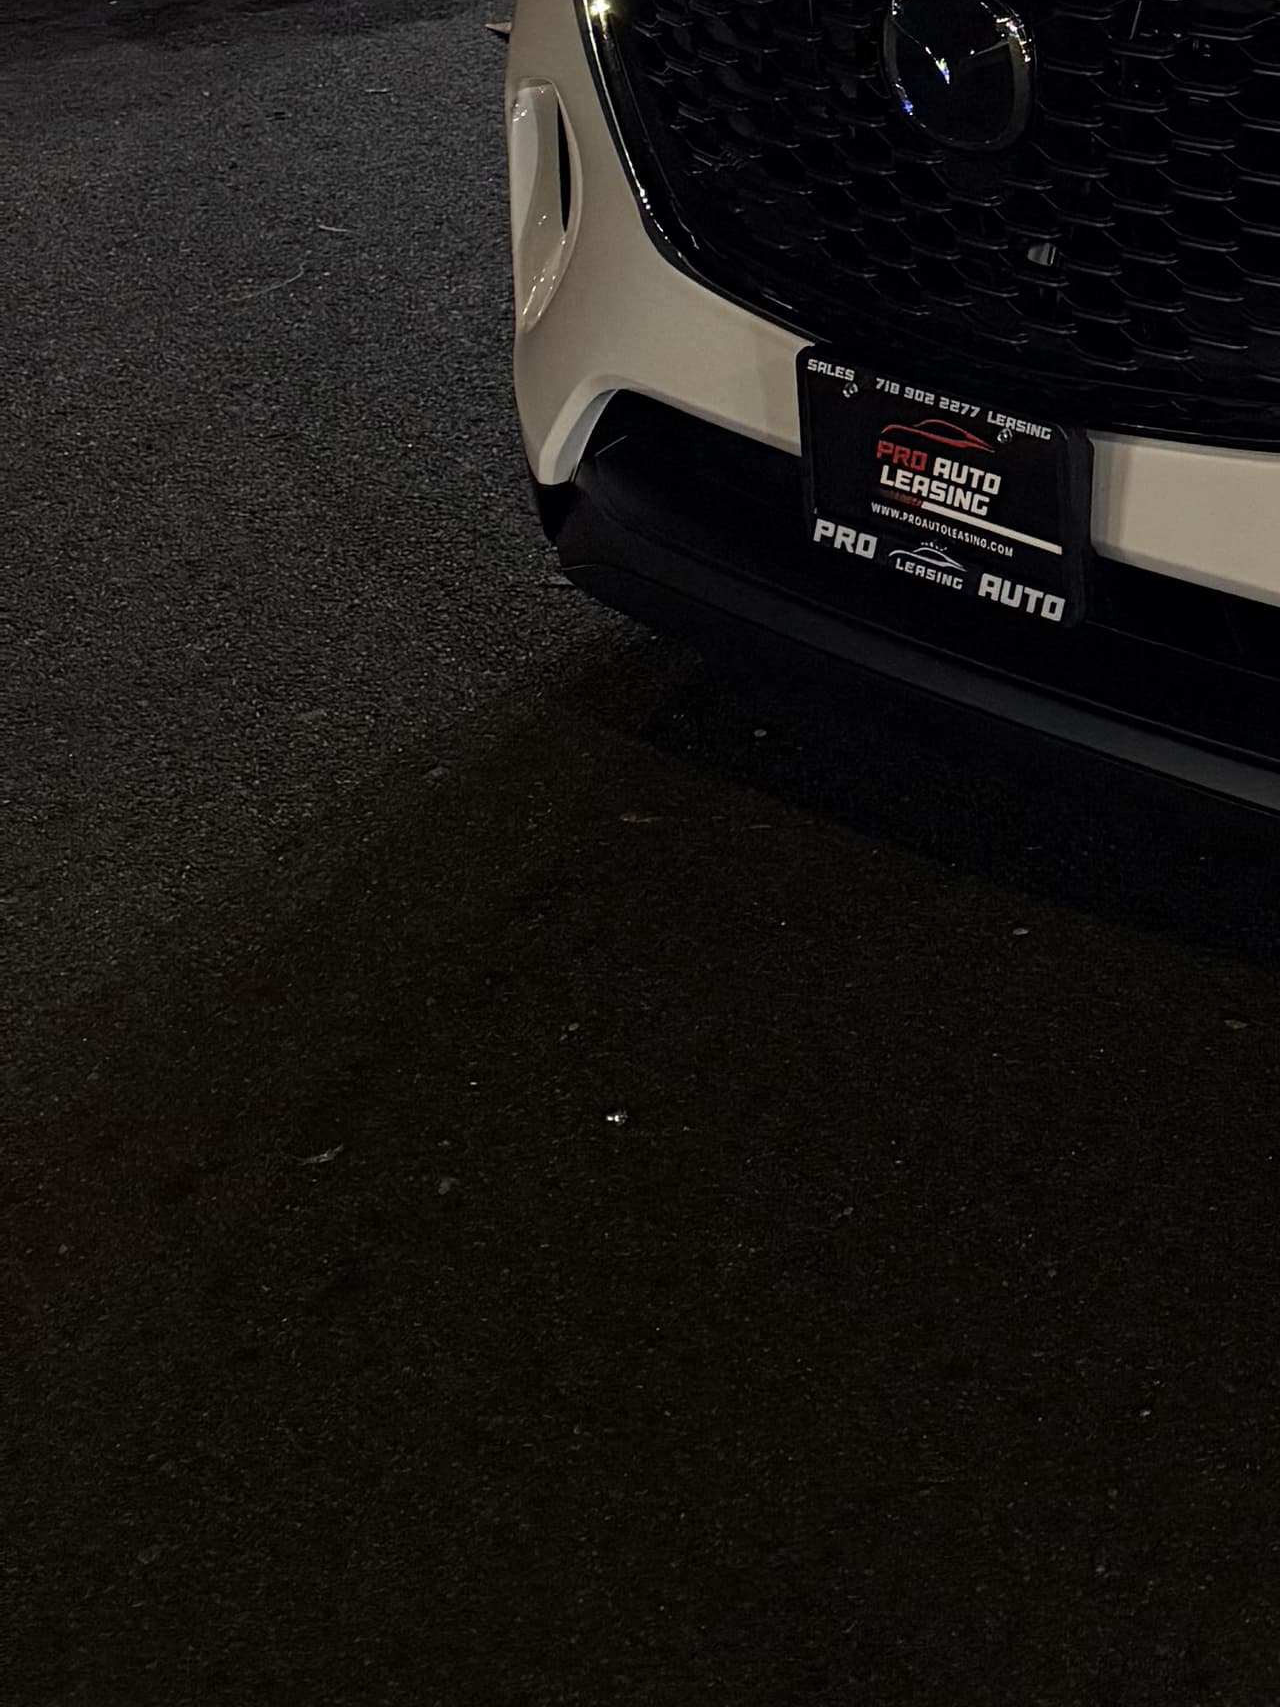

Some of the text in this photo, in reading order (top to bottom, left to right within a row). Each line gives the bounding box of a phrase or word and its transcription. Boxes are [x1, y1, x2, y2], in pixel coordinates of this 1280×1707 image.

[806, 358, 1052, 441] SALES 718 902 2277 LEASING
[875, 438, 1003, 496] PRO AUTO
[879, 464, 992, 518] LEASING
[870, 500, 1015, 559] WWW.PROAUTOLEASING.COM
[812, 517, 1067, 623] PRO LEASING AUTO
